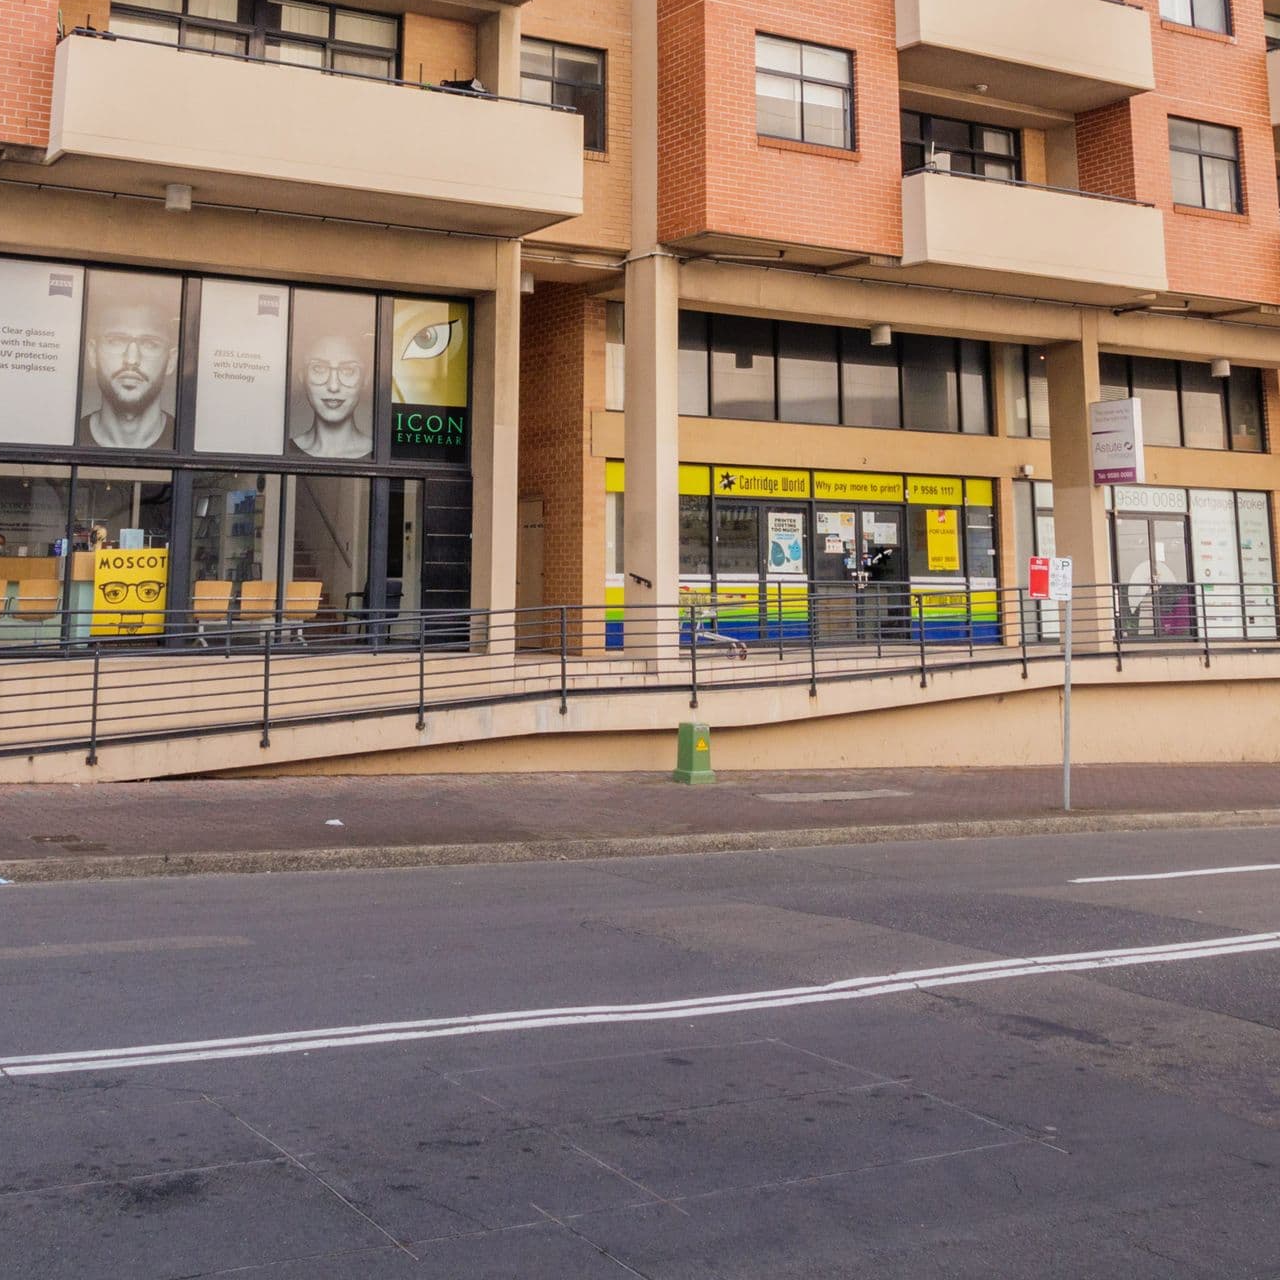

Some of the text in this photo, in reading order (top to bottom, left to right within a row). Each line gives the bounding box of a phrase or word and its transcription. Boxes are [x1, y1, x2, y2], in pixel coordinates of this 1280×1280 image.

[1, 326, 55, 337] Clear glasses
[0, 339, 61, 349] with the same
[0, 350, 58, 361] UV protection
[10, 363, 56, 373] sunglasses
[212, 372, 256, 384] Technology
[396, 413, 464, 433] ICON
[397, 433, 463, 446] EYEWEAR
[739, 475, 805, 494] Cartridge World
[815, 481, 901, 495] Why pay more to print?
[921, 486, 938, 495] 9586
[941, 487, 954, 496] 1117
[1116, 491, 1185, 508] 9580 0088
[1237, 497, 1266, 511] Broker
[98, 556, 167, 570] MOSCOT
